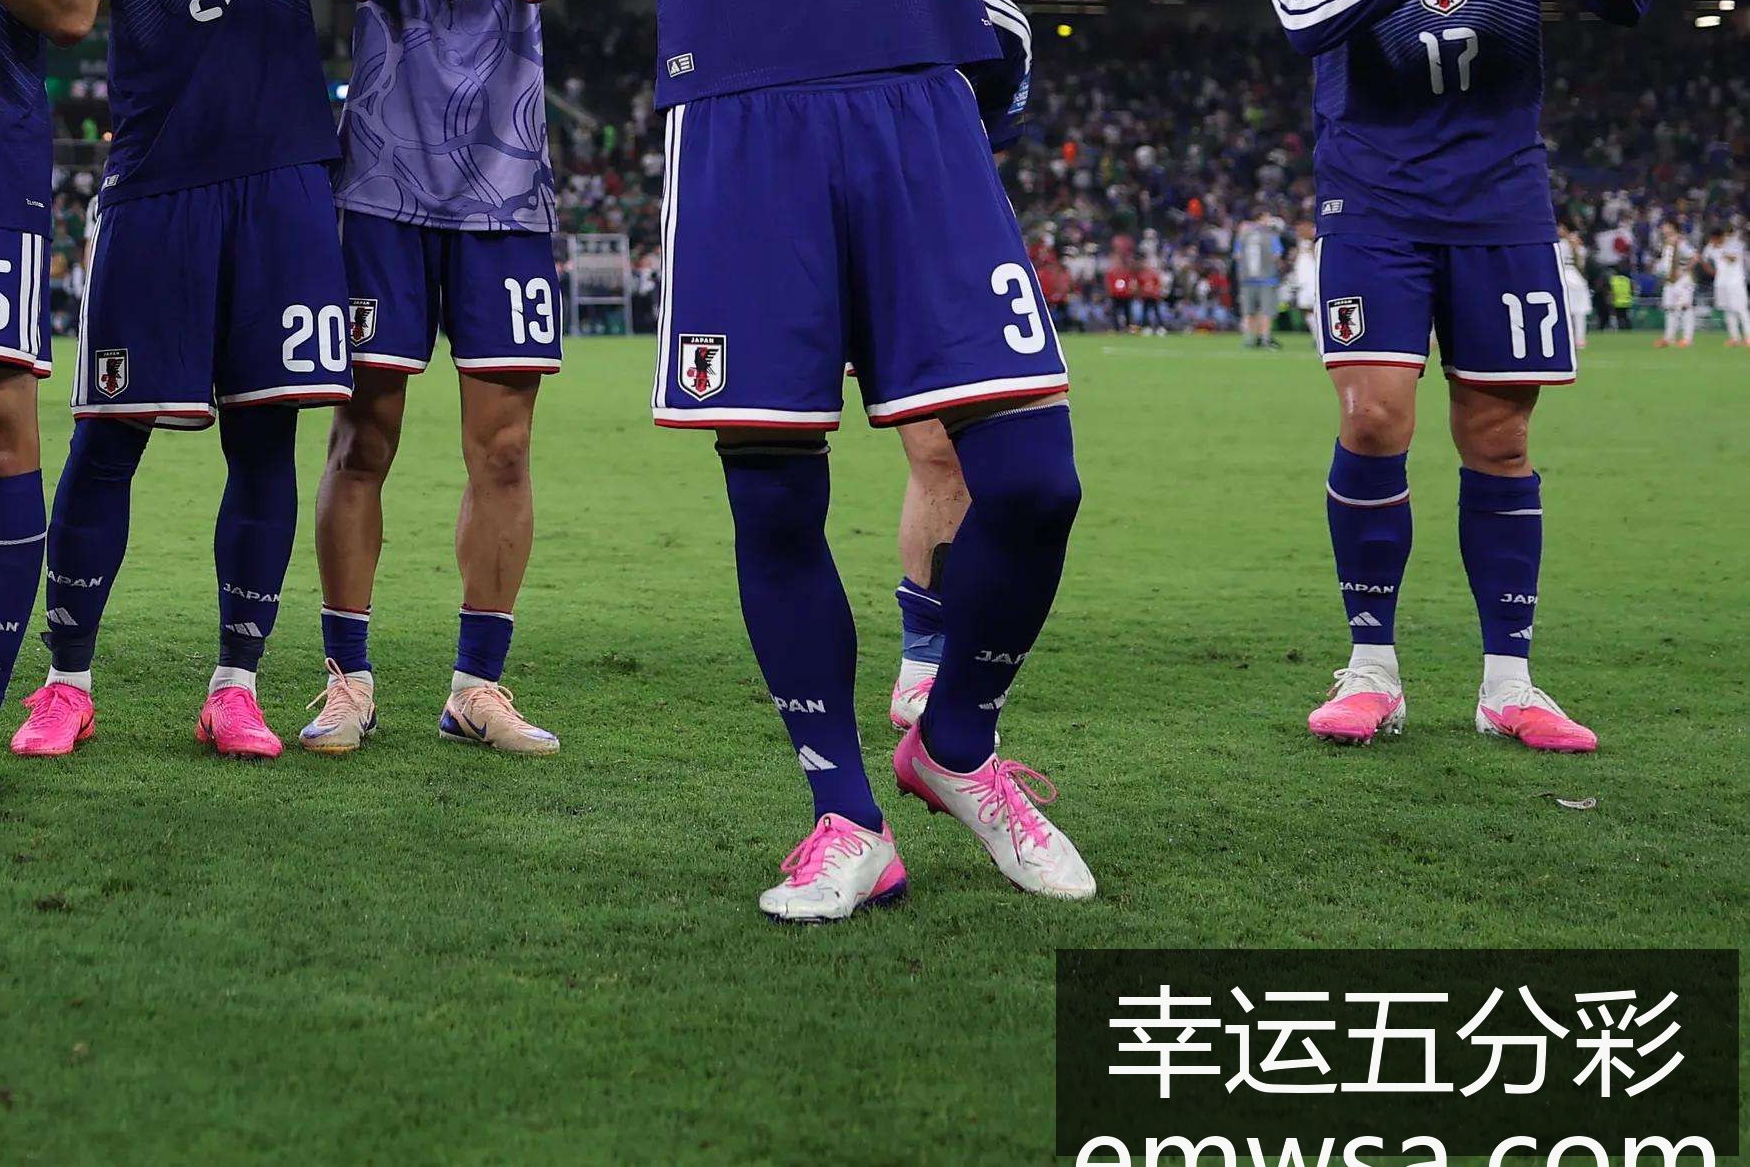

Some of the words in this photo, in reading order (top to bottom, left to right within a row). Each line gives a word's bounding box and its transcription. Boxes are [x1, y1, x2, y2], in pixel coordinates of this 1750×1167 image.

[1418, 26, 1479, 95] 17
[281, 304, 347, 373] 20
[504, 277, 555, 345] 13
[990, 262, 1046, 355] 3
[1501, 291, 1559, 359] 17
[46, 566, 103, 588] APAN
[1500, 593, 1538, 606] JAP
[771, 693, 827, 714] PAN
